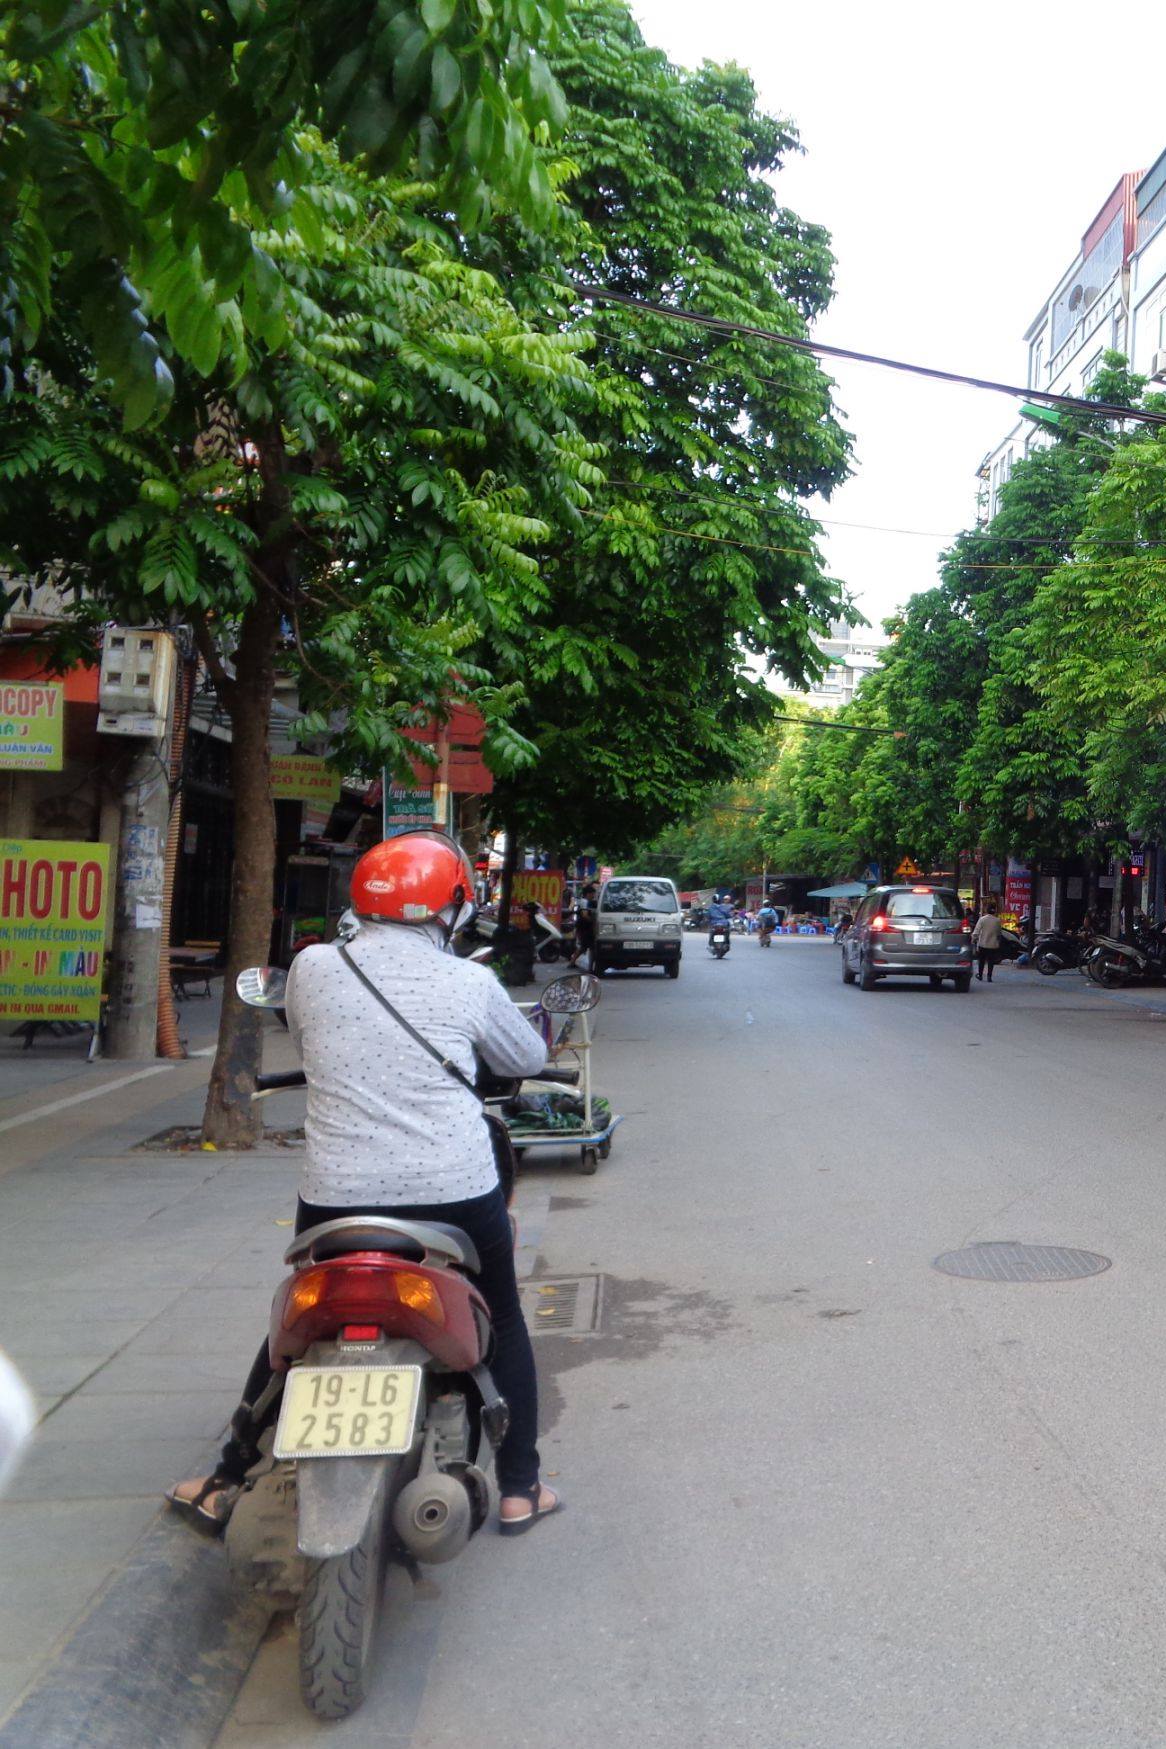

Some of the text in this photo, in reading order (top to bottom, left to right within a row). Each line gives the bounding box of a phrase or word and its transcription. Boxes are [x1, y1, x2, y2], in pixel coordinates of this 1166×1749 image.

[0, 686, 57, 718] COPY
[340, 1344, 376, 1352] HONDA
[310, 1373, 400, 1408] 19-L6
[295, 1411, 394, 1450] 2583
